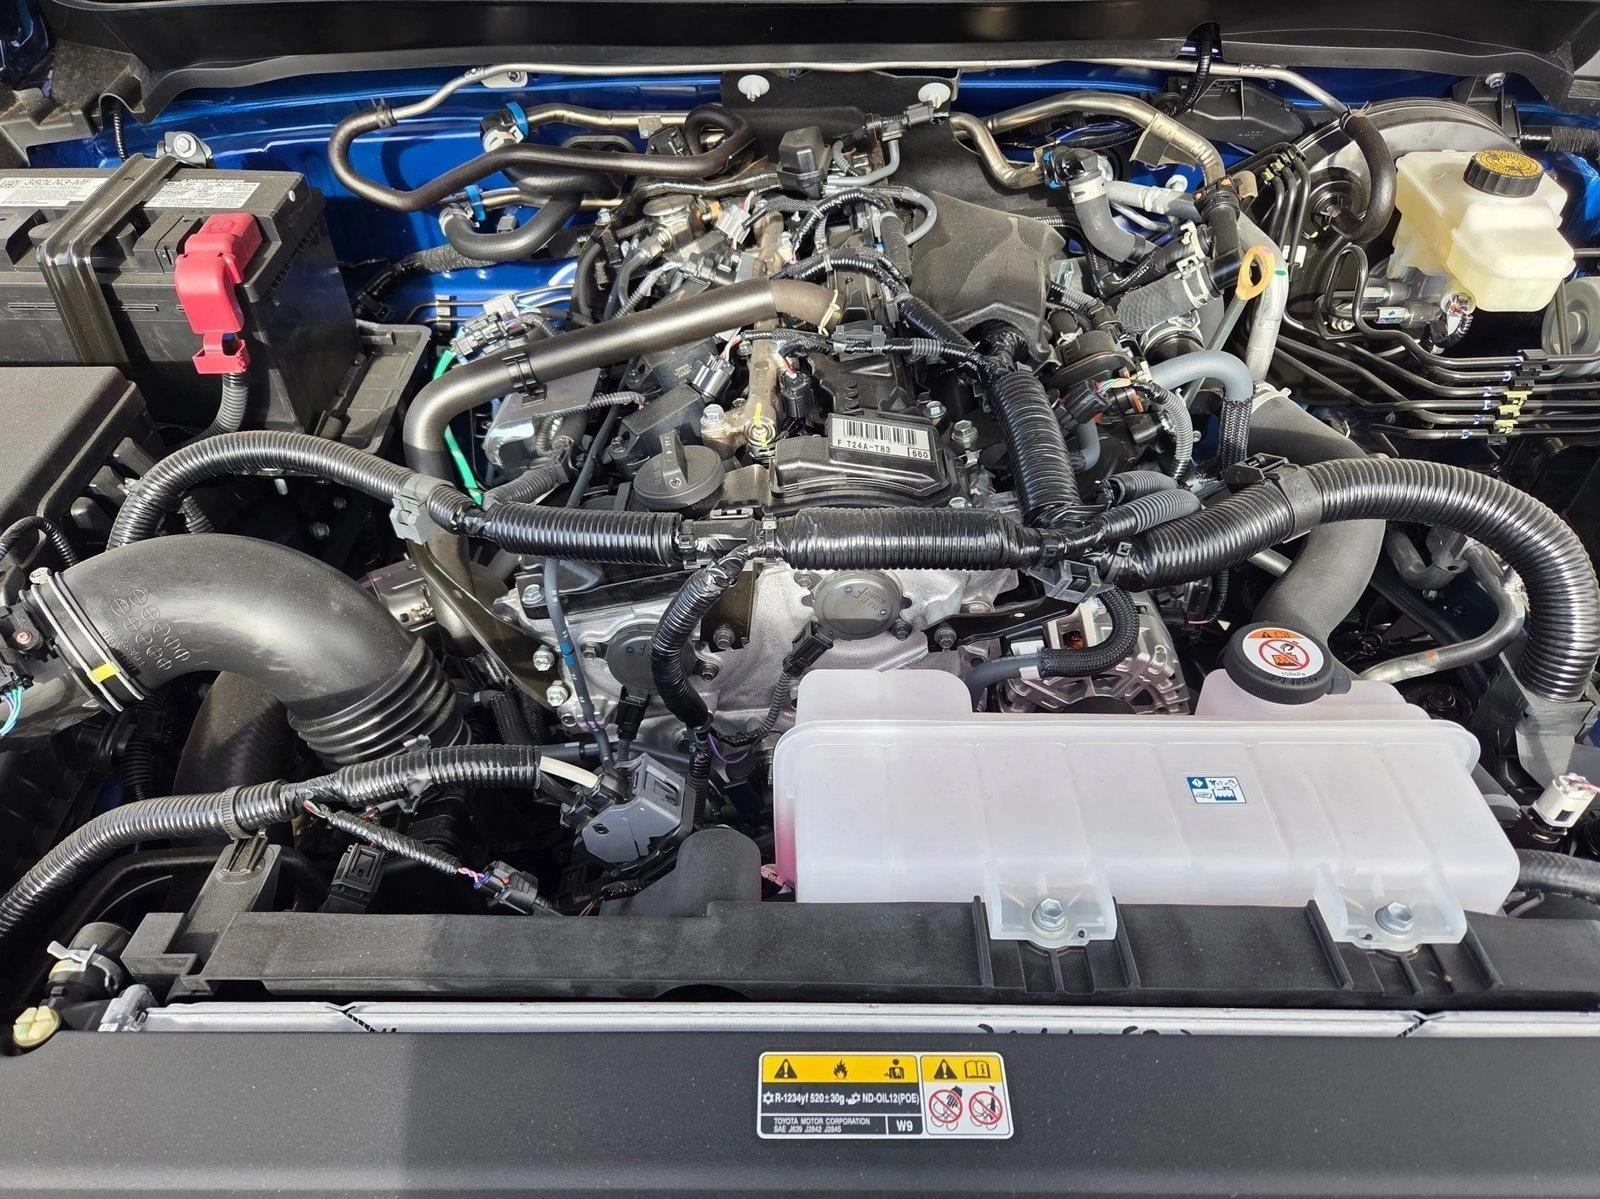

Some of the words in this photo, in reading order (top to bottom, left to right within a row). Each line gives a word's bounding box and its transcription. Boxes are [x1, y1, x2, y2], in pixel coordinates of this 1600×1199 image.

[847, 440, 891, 454] T24A-T83
[912, 450, 929, 459] 660
[775, 1092, 809, 1105] R-1234yf
[809, 1092, 845, 1105] 520±30g
[862, 1092, 920, 1105] ND-OIL12(POE)
[774, 1117, 799, 1125] TOYOTA
[800, 1117, 824, 1125] MOTOR
[825, 1117, 871, 1125] CORPORATION
[896, 1119, 914, 1132] W9
[773, 1125, 787, 1133] SAE
